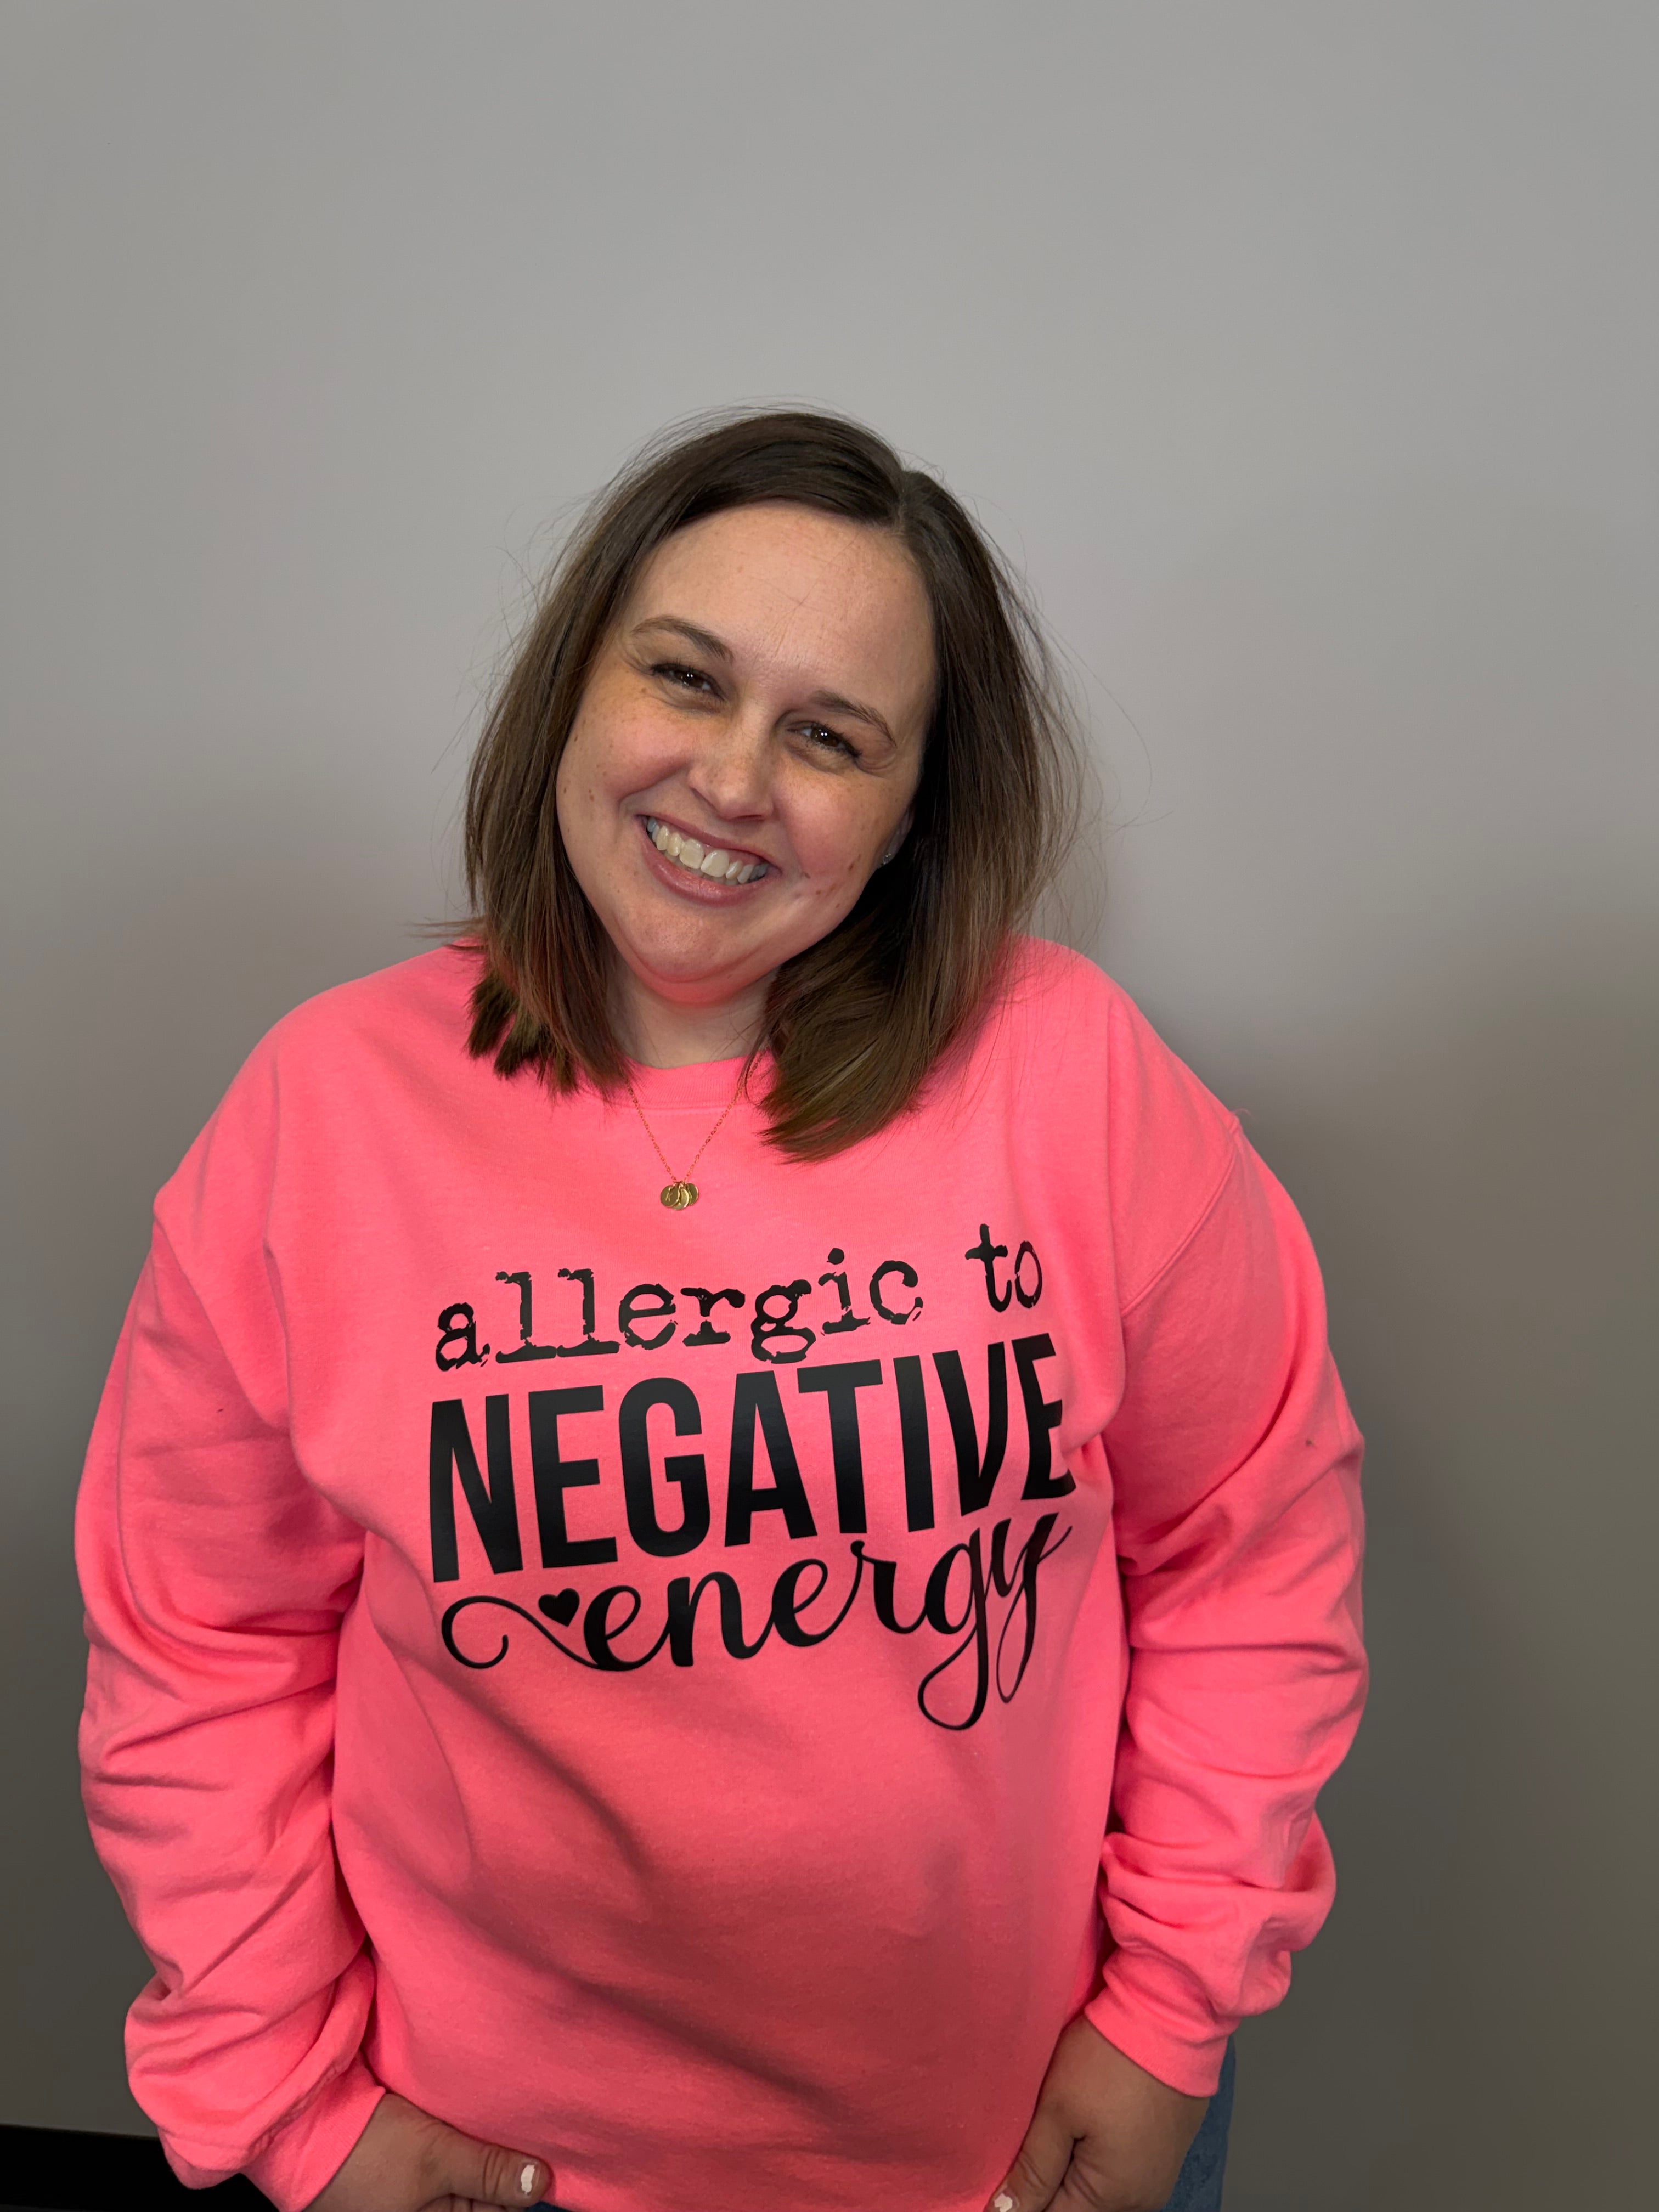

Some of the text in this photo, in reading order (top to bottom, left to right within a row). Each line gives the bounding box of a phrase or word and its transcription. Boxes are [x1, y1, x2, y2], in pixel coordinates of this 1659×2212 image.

[435, 1224, 1042, 1371] allergic to
[430, 1333, 1076, 1582] NEGATIVE
[441, 1511, 1073, 1731] energy
